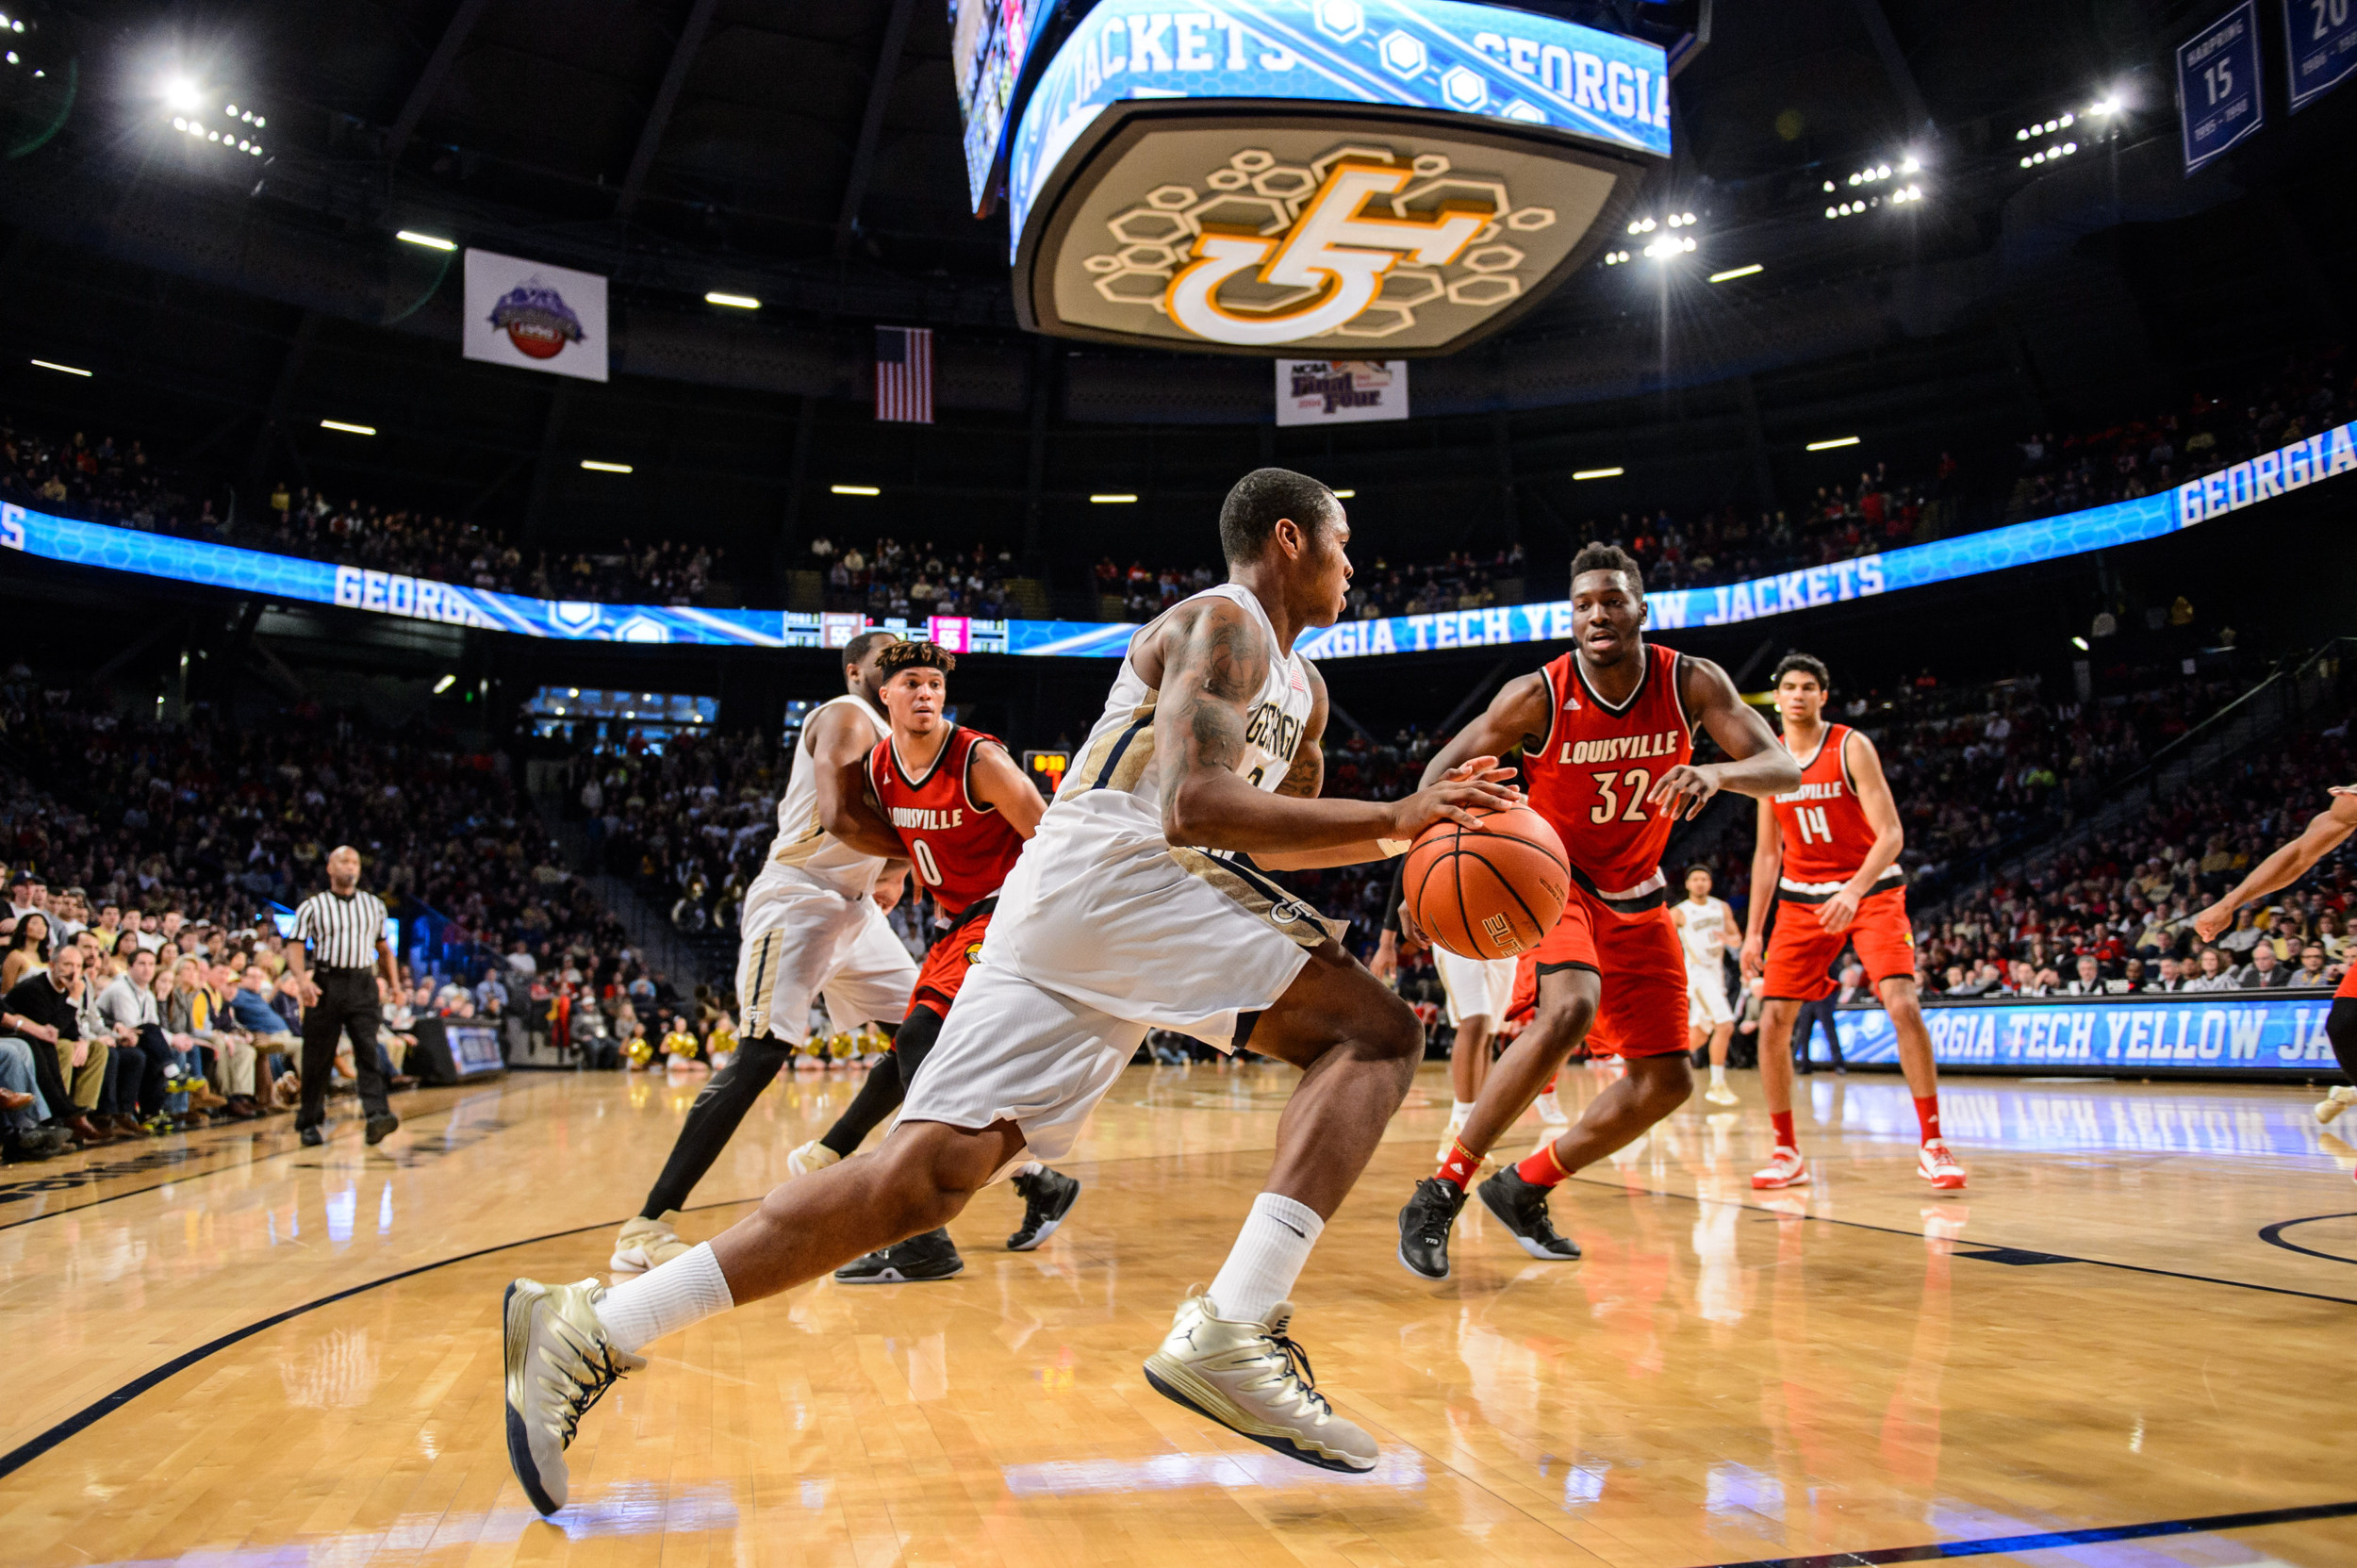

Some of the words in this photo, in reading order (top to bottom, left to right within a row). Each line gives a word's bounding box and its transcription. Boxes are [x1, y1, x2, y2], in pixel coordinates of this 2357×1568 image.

[2203, 57, 2233, 106] 15
[2178, 424, 2357, 528] GEORGIA
[1408, 606, 1512, 652] TECH
[1704, 554, 1885, 626] JACKETS
[1558, 729, 1679, 765] LOUISVILLE
[1589, 767, 1651, 825] 32
[1793, 805, 1833, 845] 14
[912, 838, 943, 886] 0
[2008, 1012, 2097, 1059] TECH
[2105, 1009, 2268, 1059] YELLOW
